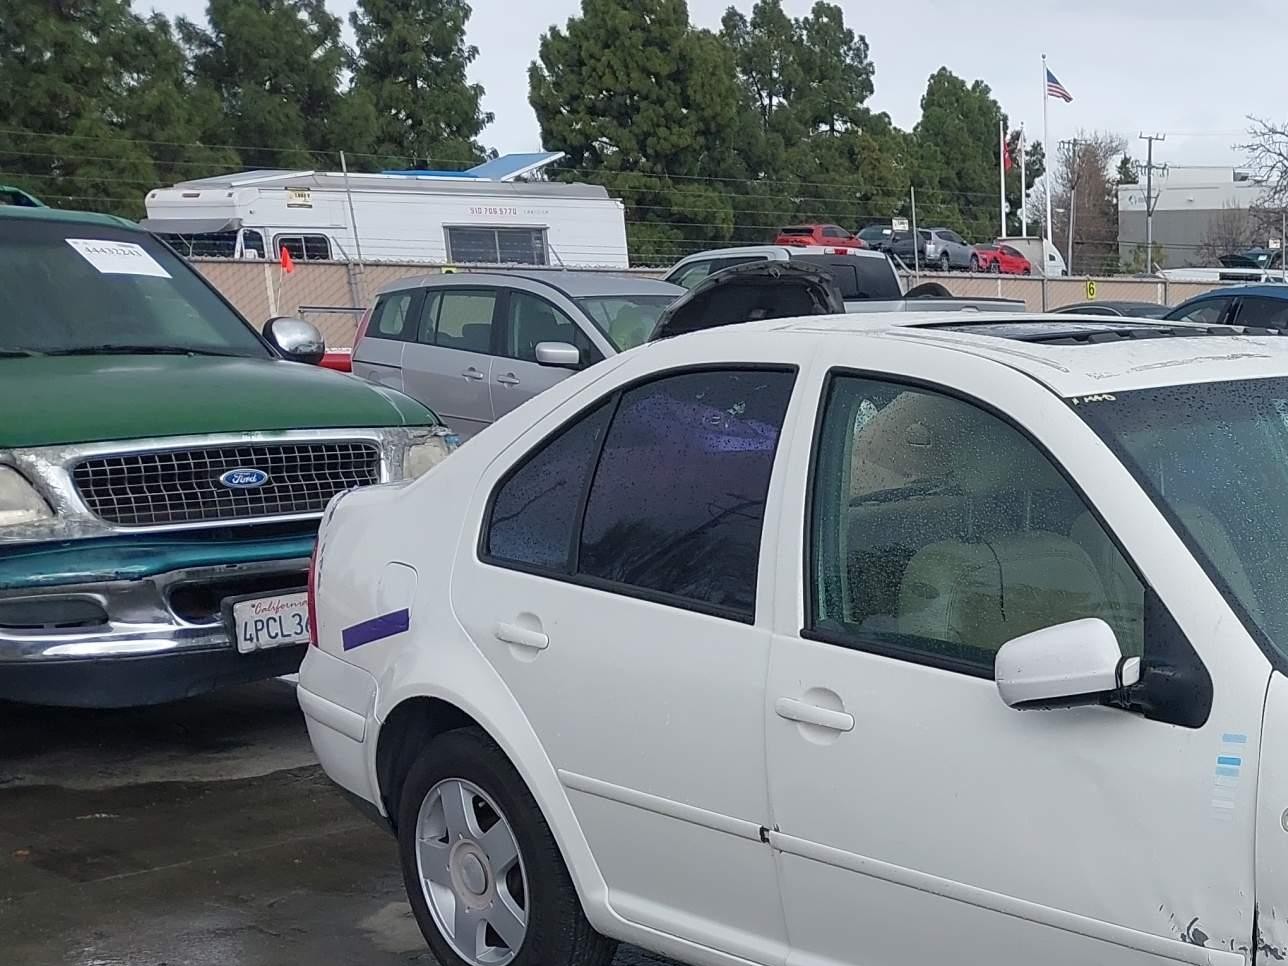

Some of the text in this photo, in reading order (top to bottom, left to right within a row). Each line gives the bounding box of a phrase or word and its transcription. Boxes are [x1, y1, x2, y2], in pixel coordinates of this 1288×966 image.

[1088, 281, 1095, 297] 6
[232, 472, 258, 484] Ford
[254, 599, 309, 615] California
